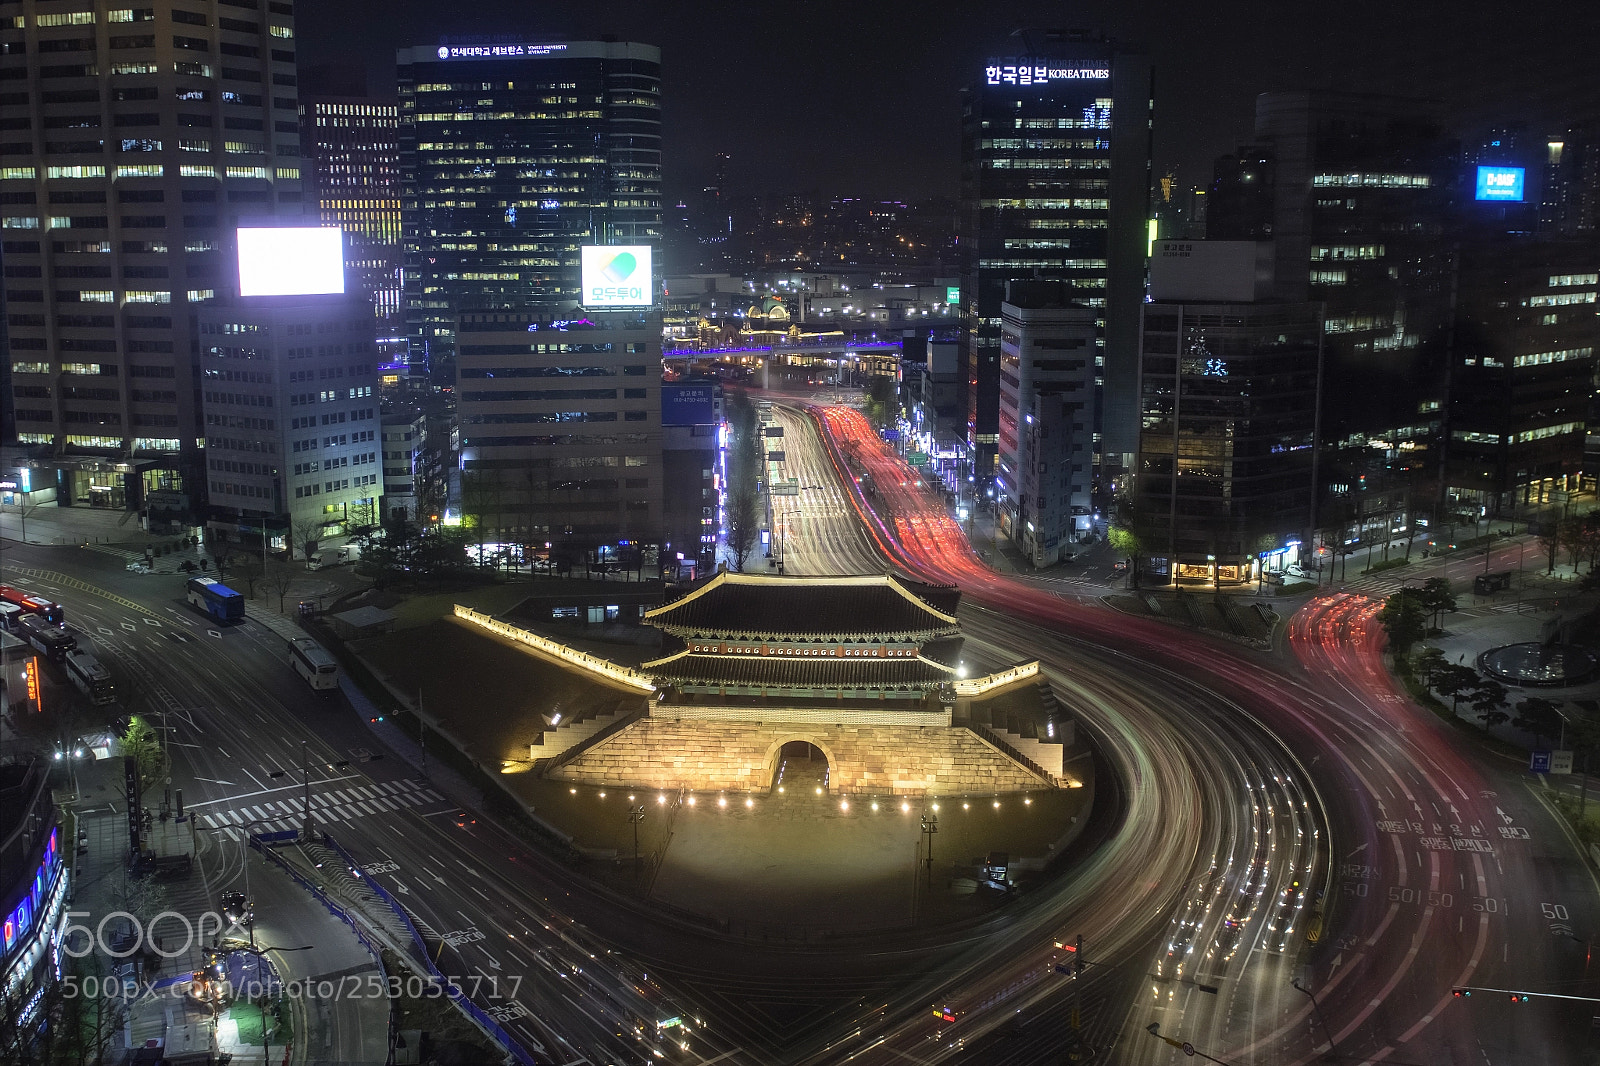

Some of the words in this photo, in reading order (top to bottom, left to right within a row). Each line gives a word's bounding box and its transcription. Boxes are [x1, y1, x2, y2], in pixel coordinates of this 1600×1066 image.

[451, 47, 491, 57] 연세대학교
[492, 45, 524, 56] 세브란스
[985, 66, 1049, 85] 한국일보
[592, 287, 643, 301] 모두투어
[1388, 886, 1413, 903] 50
[1428, 891, 1453, 908] 50
[1541, 902, 1569, 920] 50
